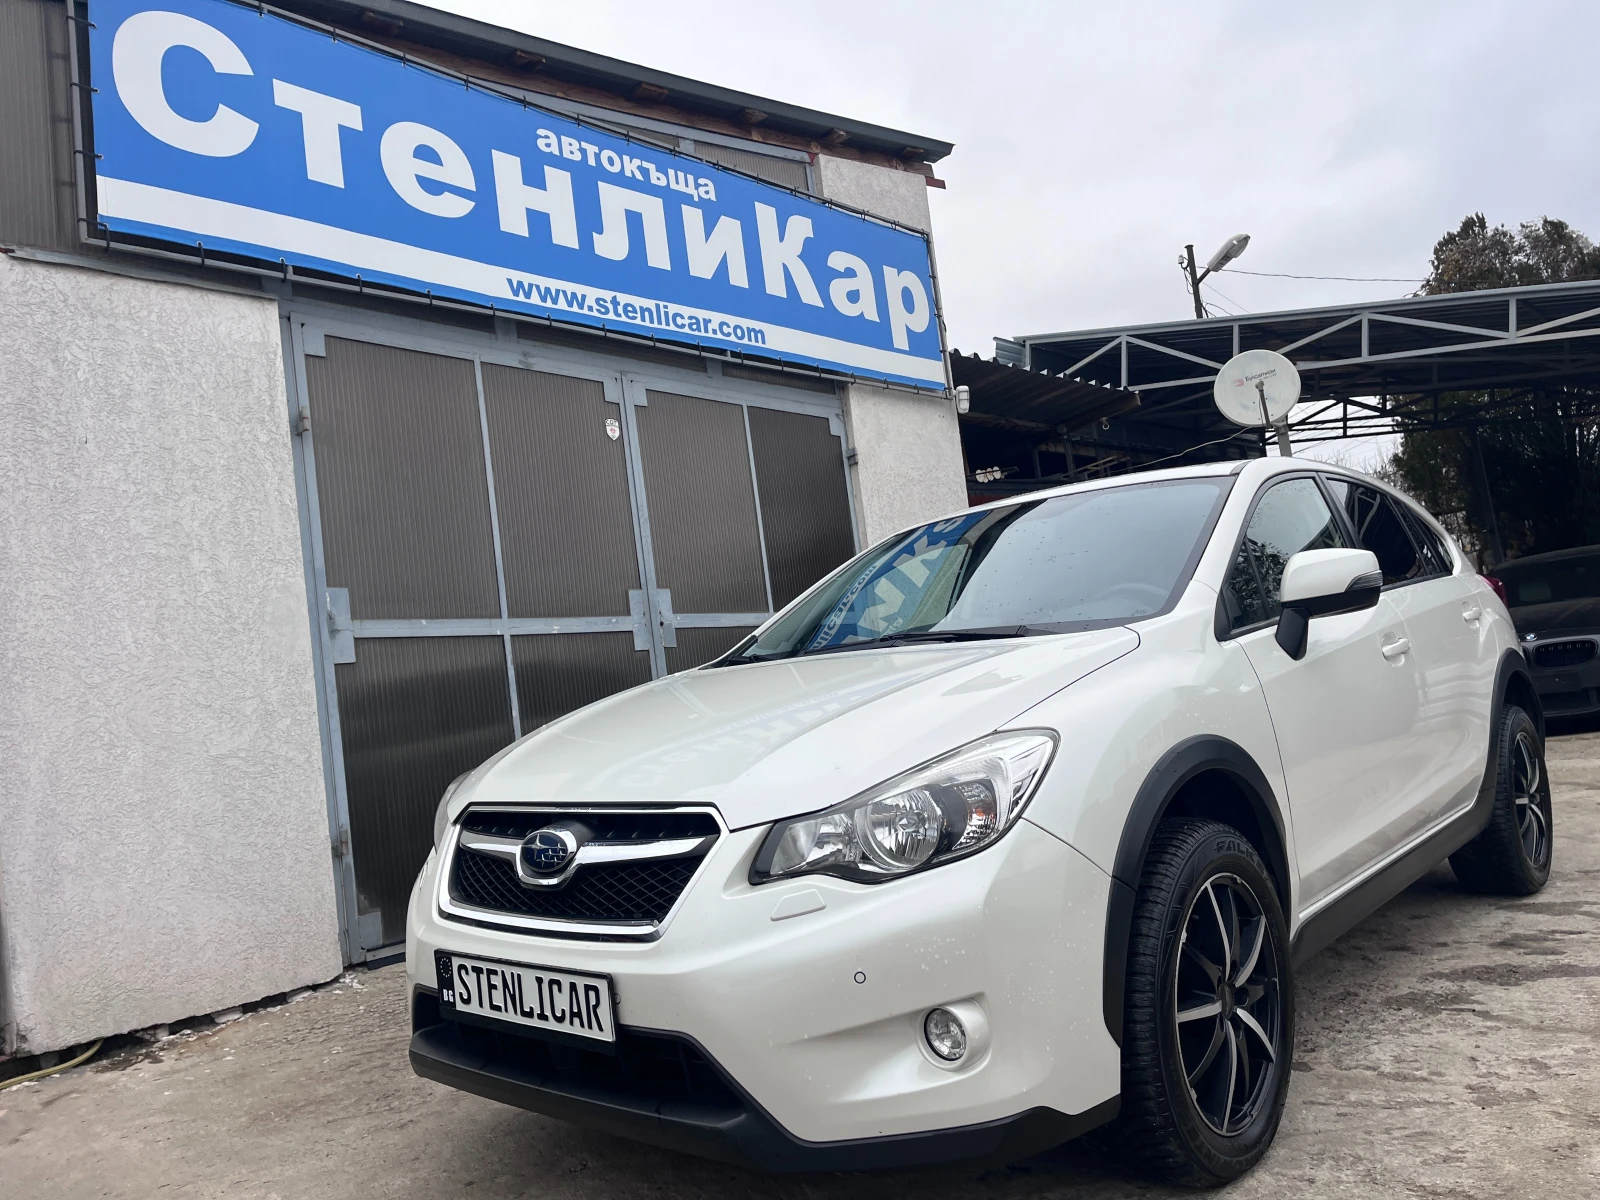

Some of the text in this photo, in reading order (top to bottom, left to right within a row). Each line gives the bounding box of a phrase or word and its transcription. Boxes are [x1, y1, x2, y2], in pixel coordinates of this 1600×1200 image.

[112, 10, 930, 351] СтенлиКар
[536, 128, 717, 202] автокъща
[506, 278, 766, 345] www.stenlicar.com
[442, 988, 454, 1002] BG
[457, 963, 604, 1032] STENLICAR
